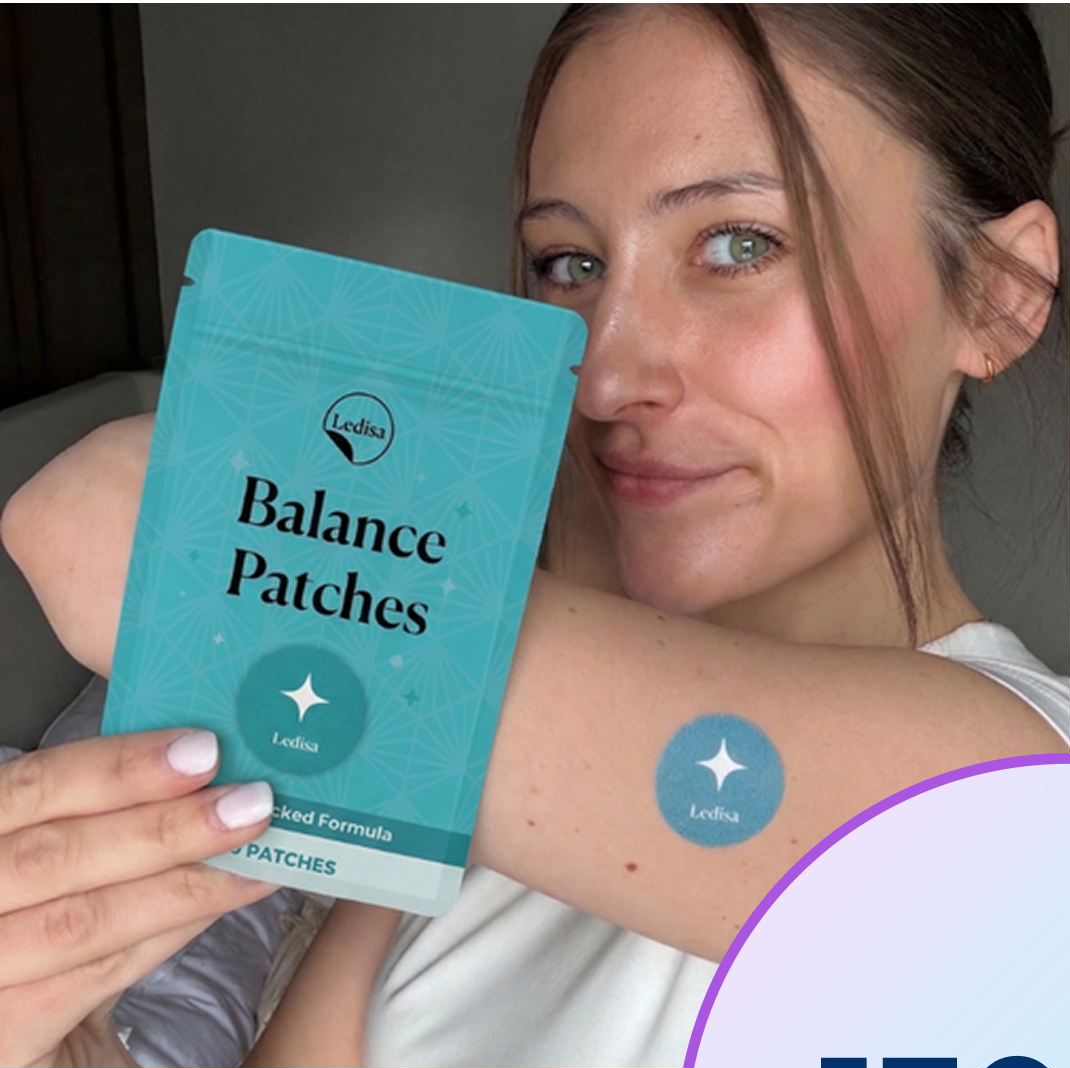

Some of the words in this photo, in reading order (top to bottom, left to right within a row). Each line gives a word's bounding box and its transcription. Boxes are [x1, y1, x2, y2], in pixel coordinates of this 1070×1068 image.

[331, 413, 386, 439] Ledisa
[236, 474, 448, 565] Balance
[225, 547, 431, 637] Patches
[272, 731, 319, 753] Ledisa
[272, 804, 315, 825] cked
[318, 813, 393, 843] Formula
[246, 843, 337, 876] PATCHES
